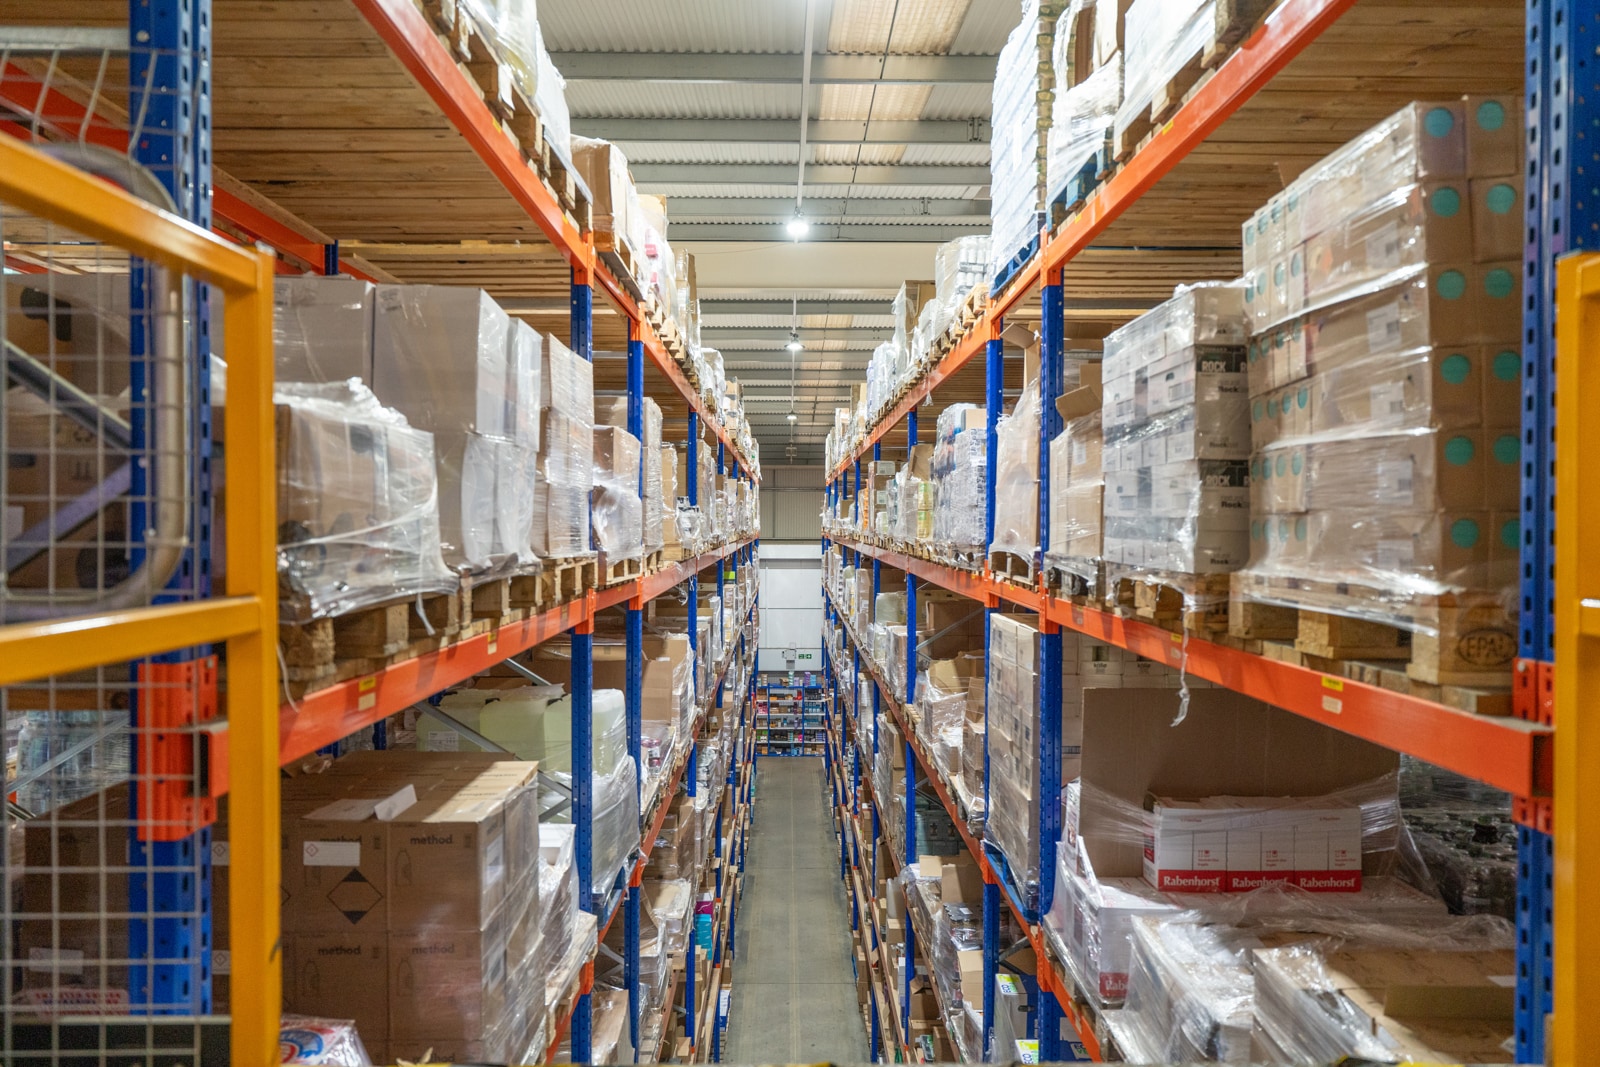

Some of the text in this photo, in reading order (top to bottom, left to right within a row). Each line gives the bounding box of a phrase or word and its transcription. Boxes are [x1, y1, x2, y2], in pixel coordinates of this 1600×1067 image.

[1201, 361, 1226, 373] ROCK
[410, 834, 453, 845] method
[1163, 875, 1220, 887] Rabenhorst
[1232, 875, 1289, 888] Rabenhorst
[1300, 876, 1356, 888] Rabenhorst
[318, 945, 361, 955] method
